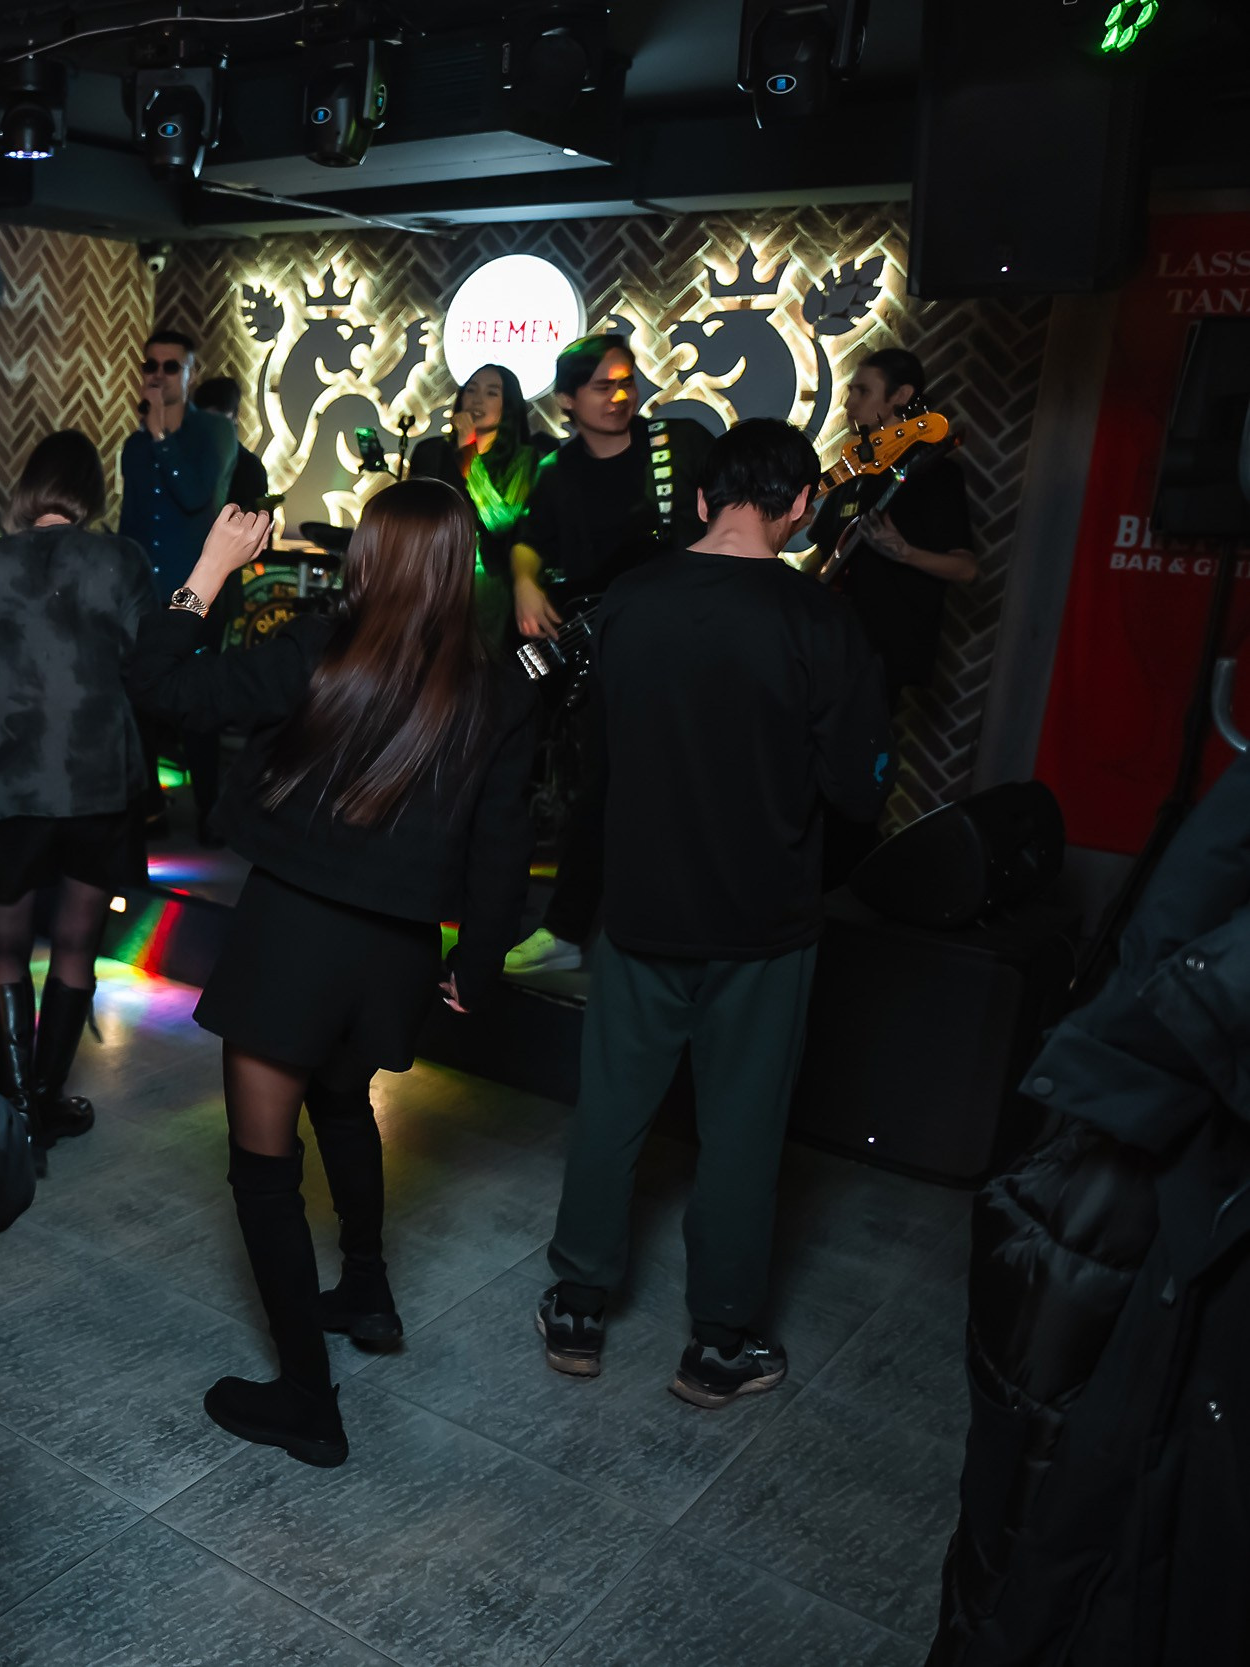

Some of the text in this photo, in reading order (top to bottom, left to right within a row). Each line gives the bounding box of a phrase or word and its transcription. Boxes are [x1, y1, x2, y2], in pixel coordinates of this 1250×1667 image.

[1166, 287, 1250, 313] TAN
[461, 320, 562, 343] BREMEN
[1109, 552, 1162, 573] BAR
[1167, 557, 1187, 575] &
